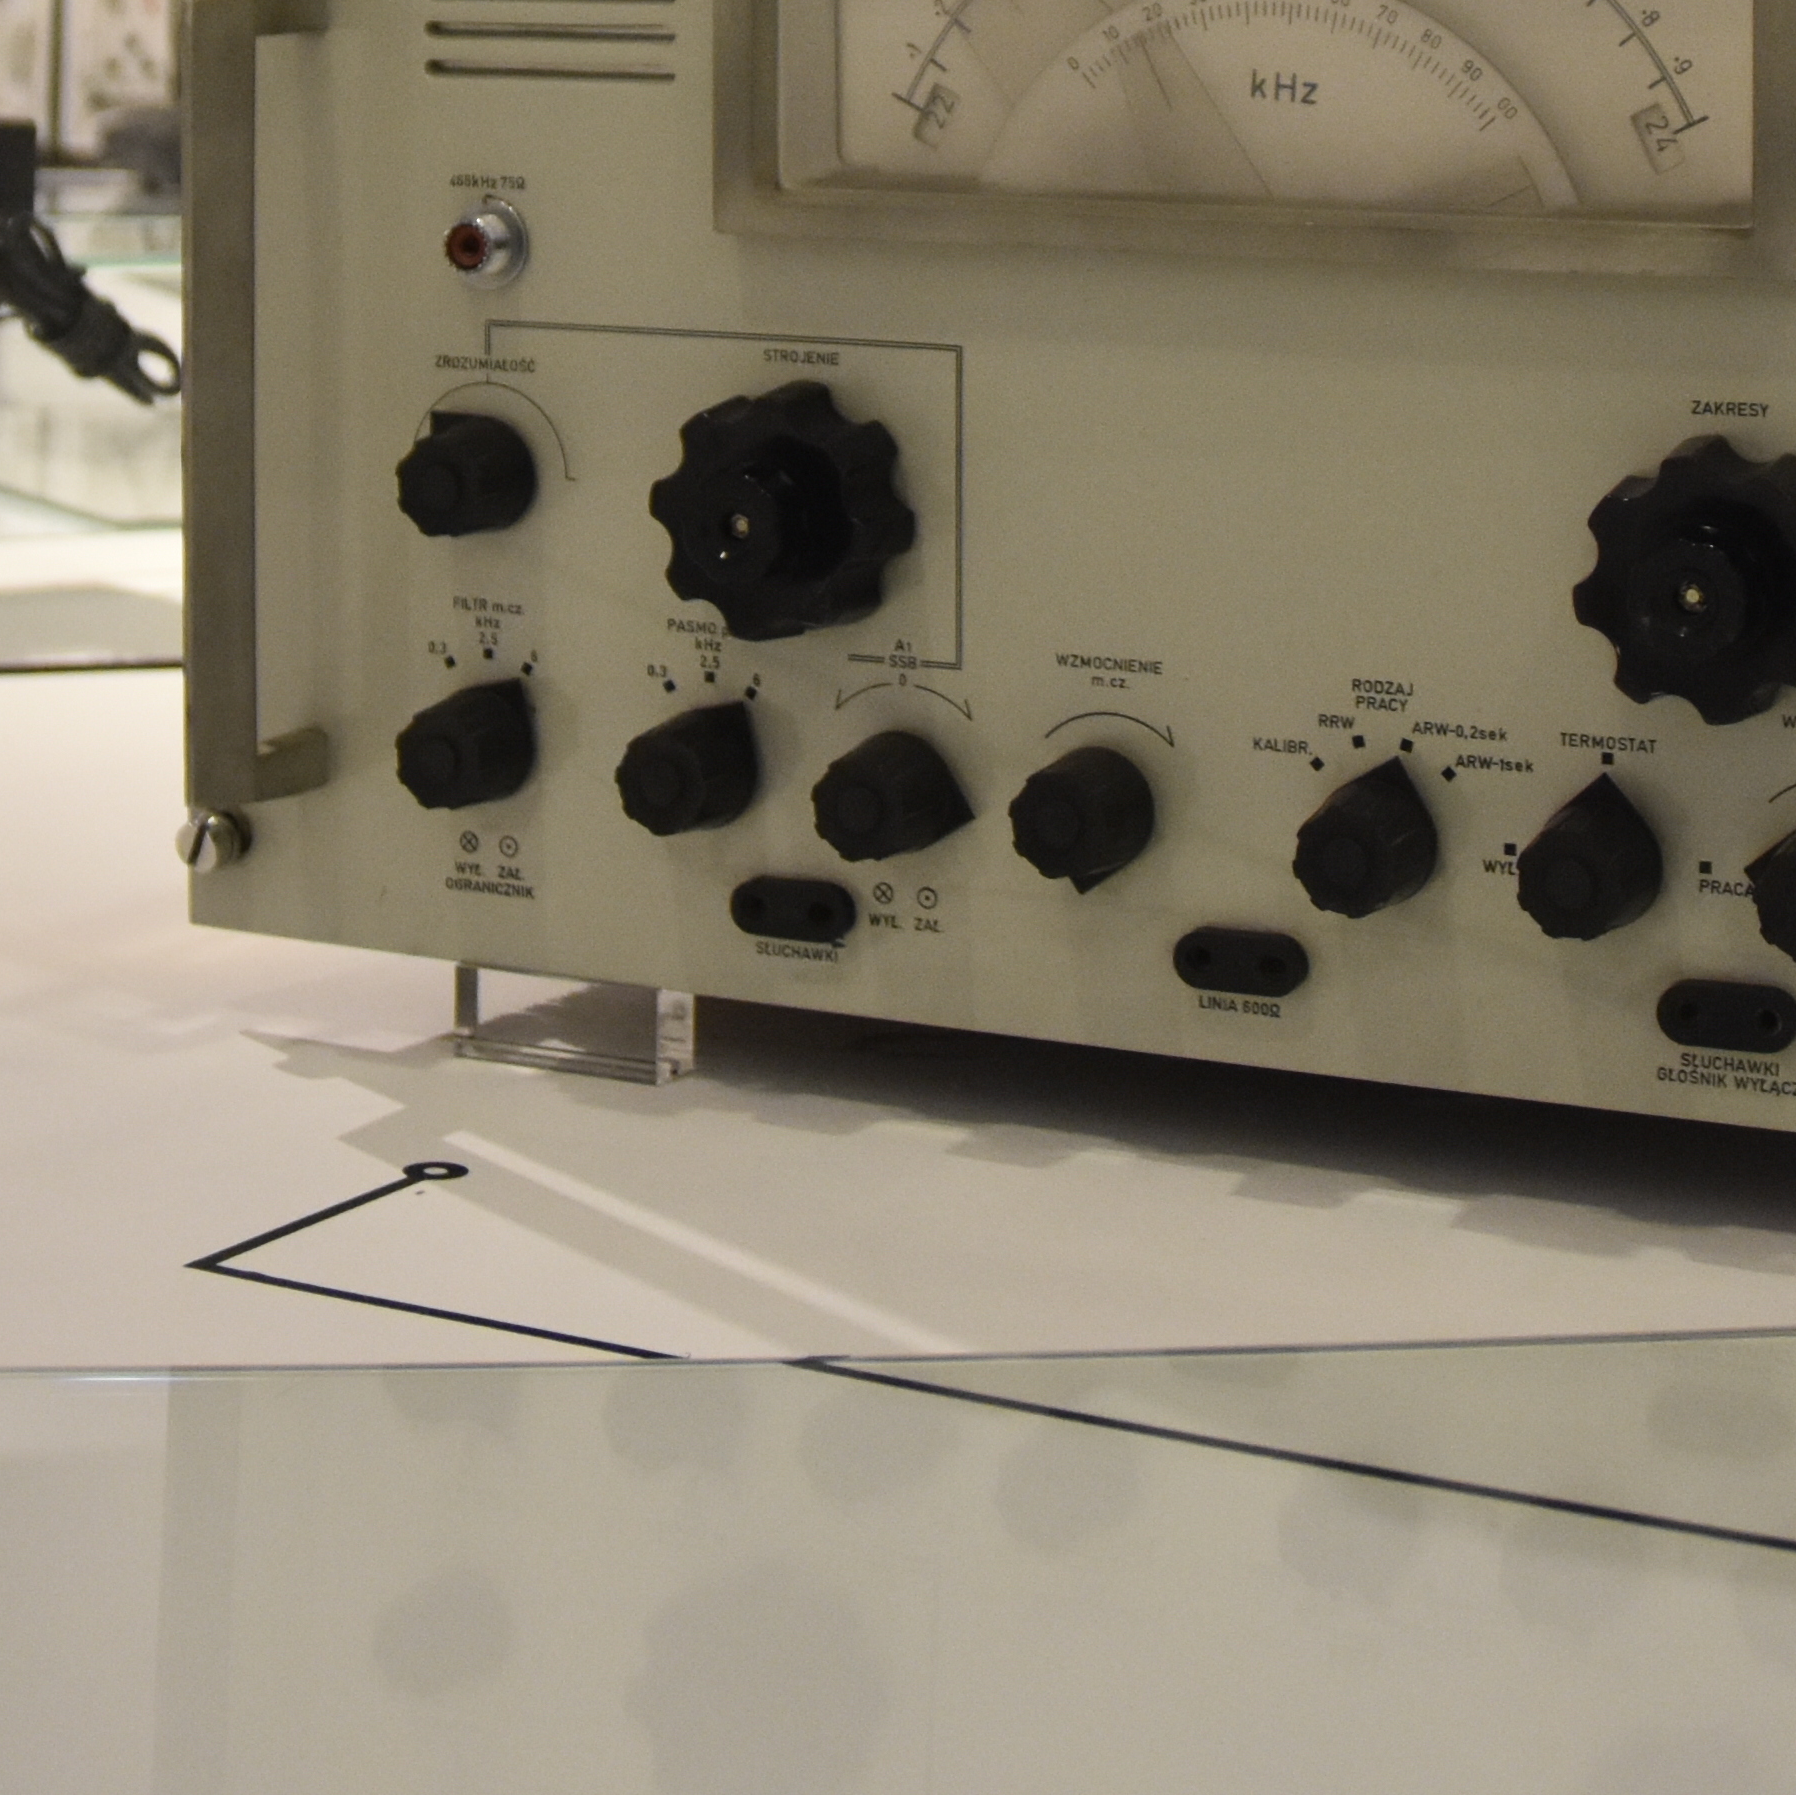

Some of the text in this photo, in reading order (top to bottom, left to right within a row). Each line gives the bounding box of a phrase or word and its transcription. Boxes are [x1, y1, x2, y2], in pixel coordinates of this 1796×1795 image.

[1102, 25, 1120, 41] 10
[1379, 4, 1399, 25] 70
[1420, 28, 1442, 49] 80
[1462, 60, 1483, 82] 90
[1250, 68, 1318, 105] kHz
[1645, 115, 1679, 153] 24
[763, 348, 840, 366] STROJENIE
[1691, 400, 1769, 418] ZAKRESY
[452, 595, 488, 611] FILTR
[475, 615, 501, 630] kHz
[667, 617, 717, 635] PASMO
[695, 636, 722, 653] kHz
[887, 654, 919, 670] SSB
[1055, 652, 1163, 675] WZMOCNIENIE
[1351, 678, 1414, 697] RODZAJ
[1355, 695, 1409, 713] PRACY
[1318, 713, 1355, 730] RRW
[1253, 737, 1314, 756] KALIBR.
[1560, 732, 1657, 754] TERMOSTAT
[1455, 754, 1534, 774] ARW-1sek
[445, 878, 535, 899] OGRANICZNIK
[756, 941, 839, 963] SŁUCHAWKI
[1198, 995, 1238, 1013] LINIA
[1681, 1052, 1780, 1076] SŁUCHAWKI
[1657, 1064, 1727, 1089] GŁOŚNIK
